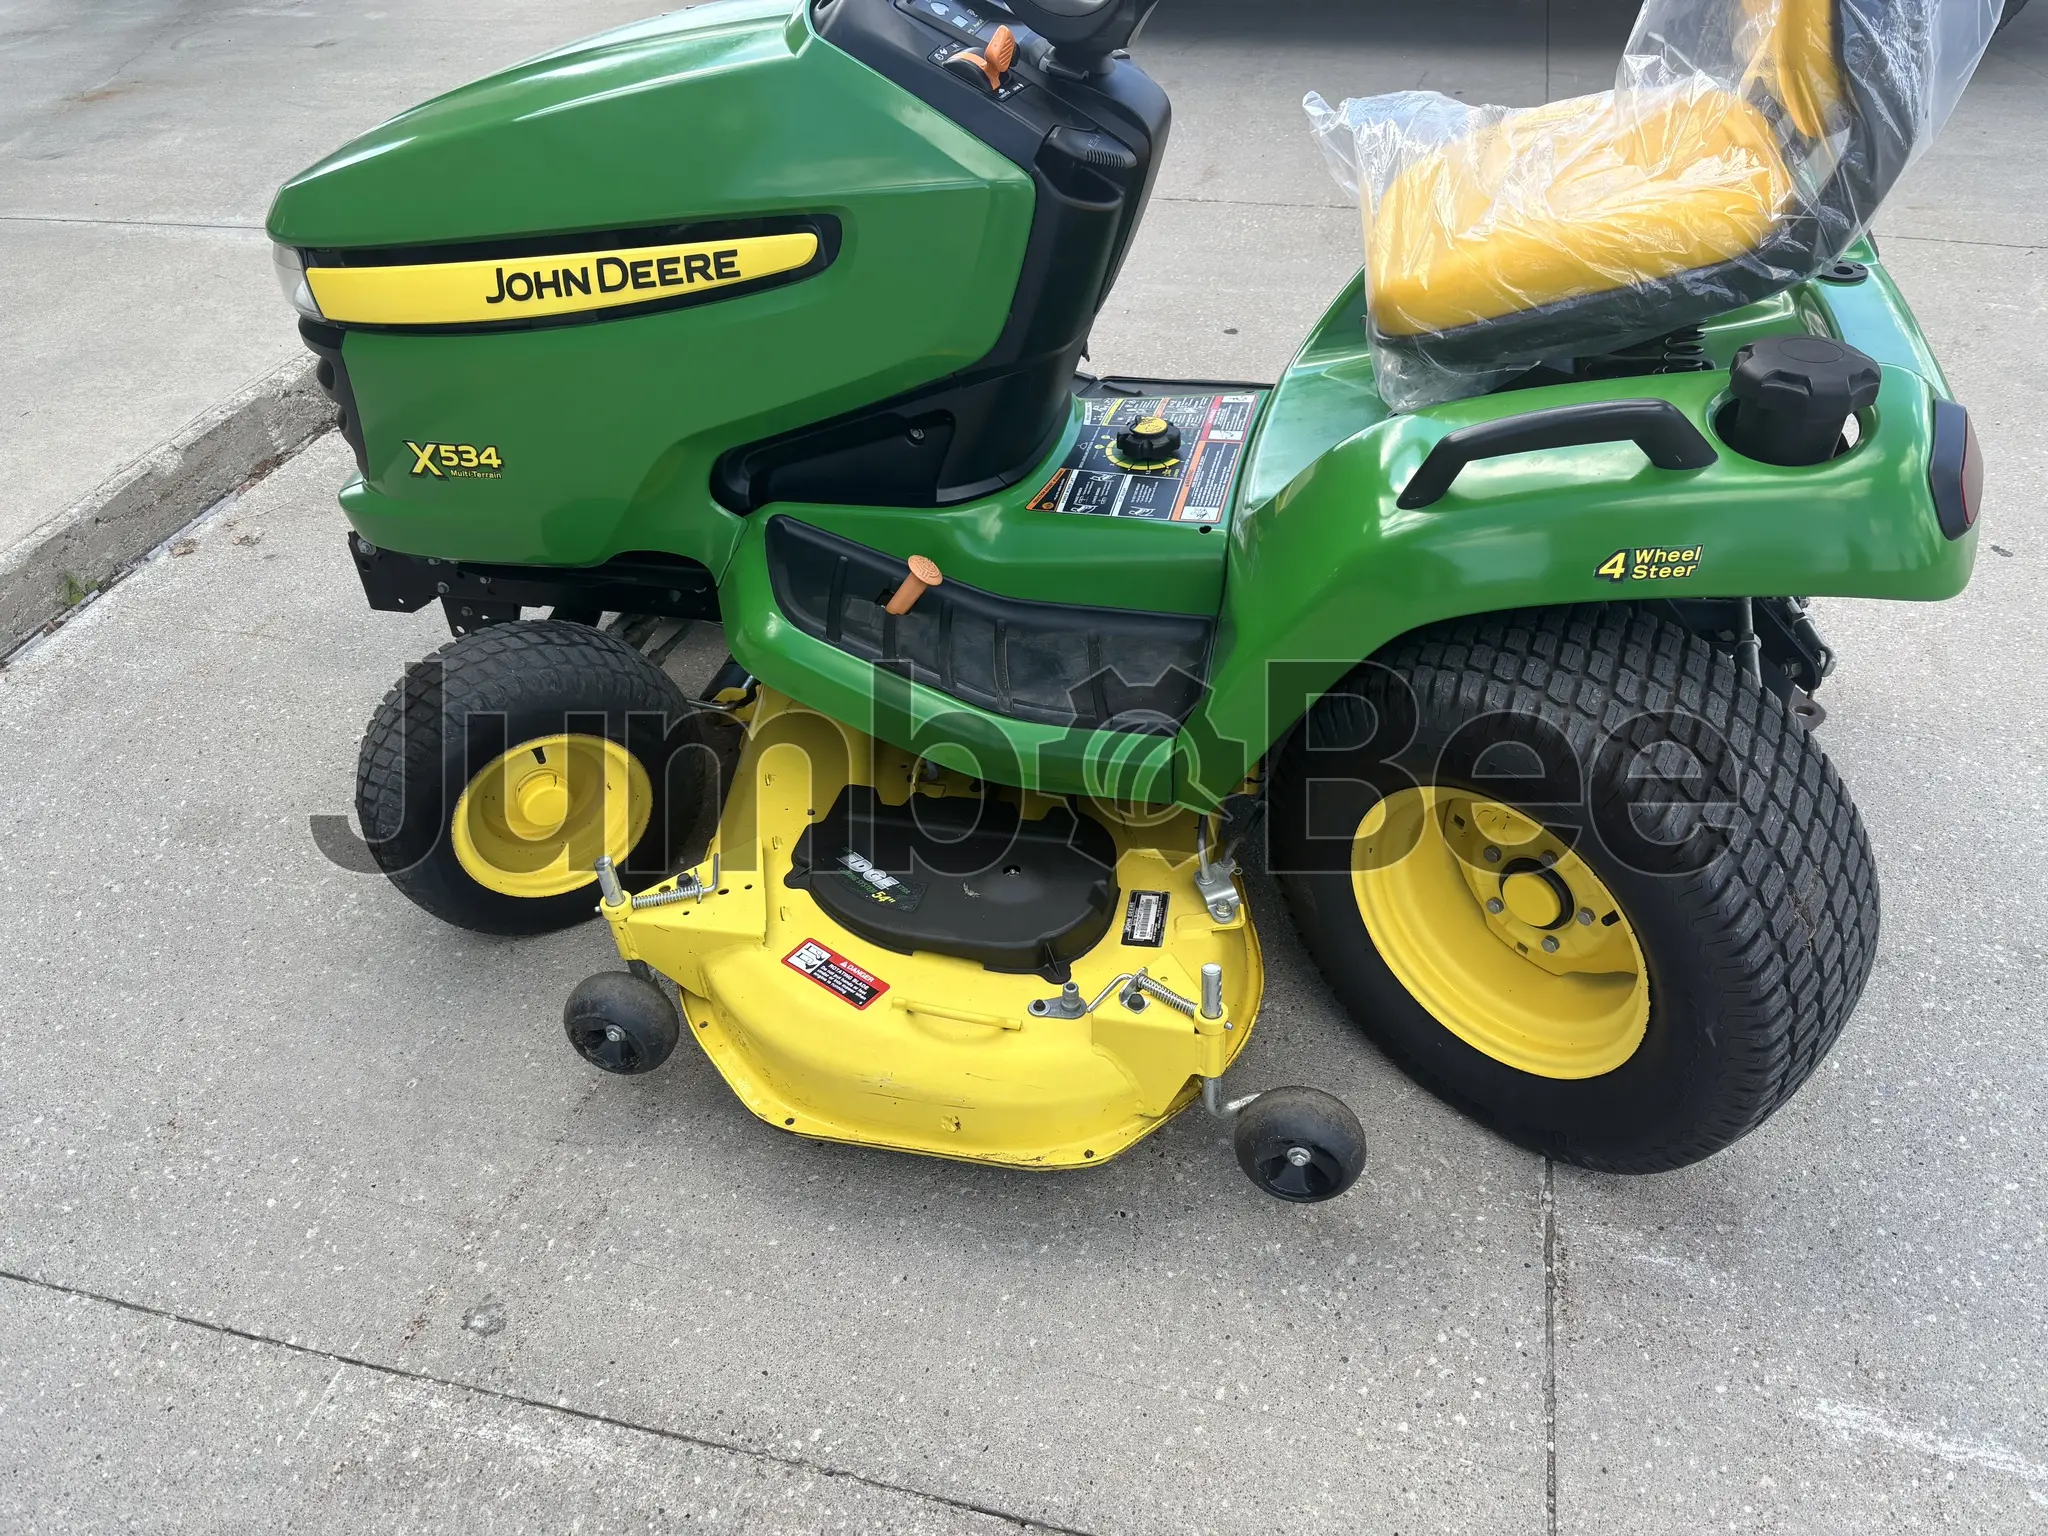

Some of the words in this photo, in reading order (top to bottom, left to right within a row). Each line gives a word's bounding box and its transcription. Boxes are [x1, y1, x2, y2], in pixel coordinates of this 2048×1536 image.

[485, 267, 592, 304] JOHN
[596, 249, 742, 294] DEERE
[404, 441, 503, 477] X534
[1598, 552, 1626, 579] 4
[1635, 545, 1702, 564] Wheel
[1631, 564, 1697, 579] Steer
[836, 851, 900, 890] EDGE
[846, 964, 875, 983] DANGER
